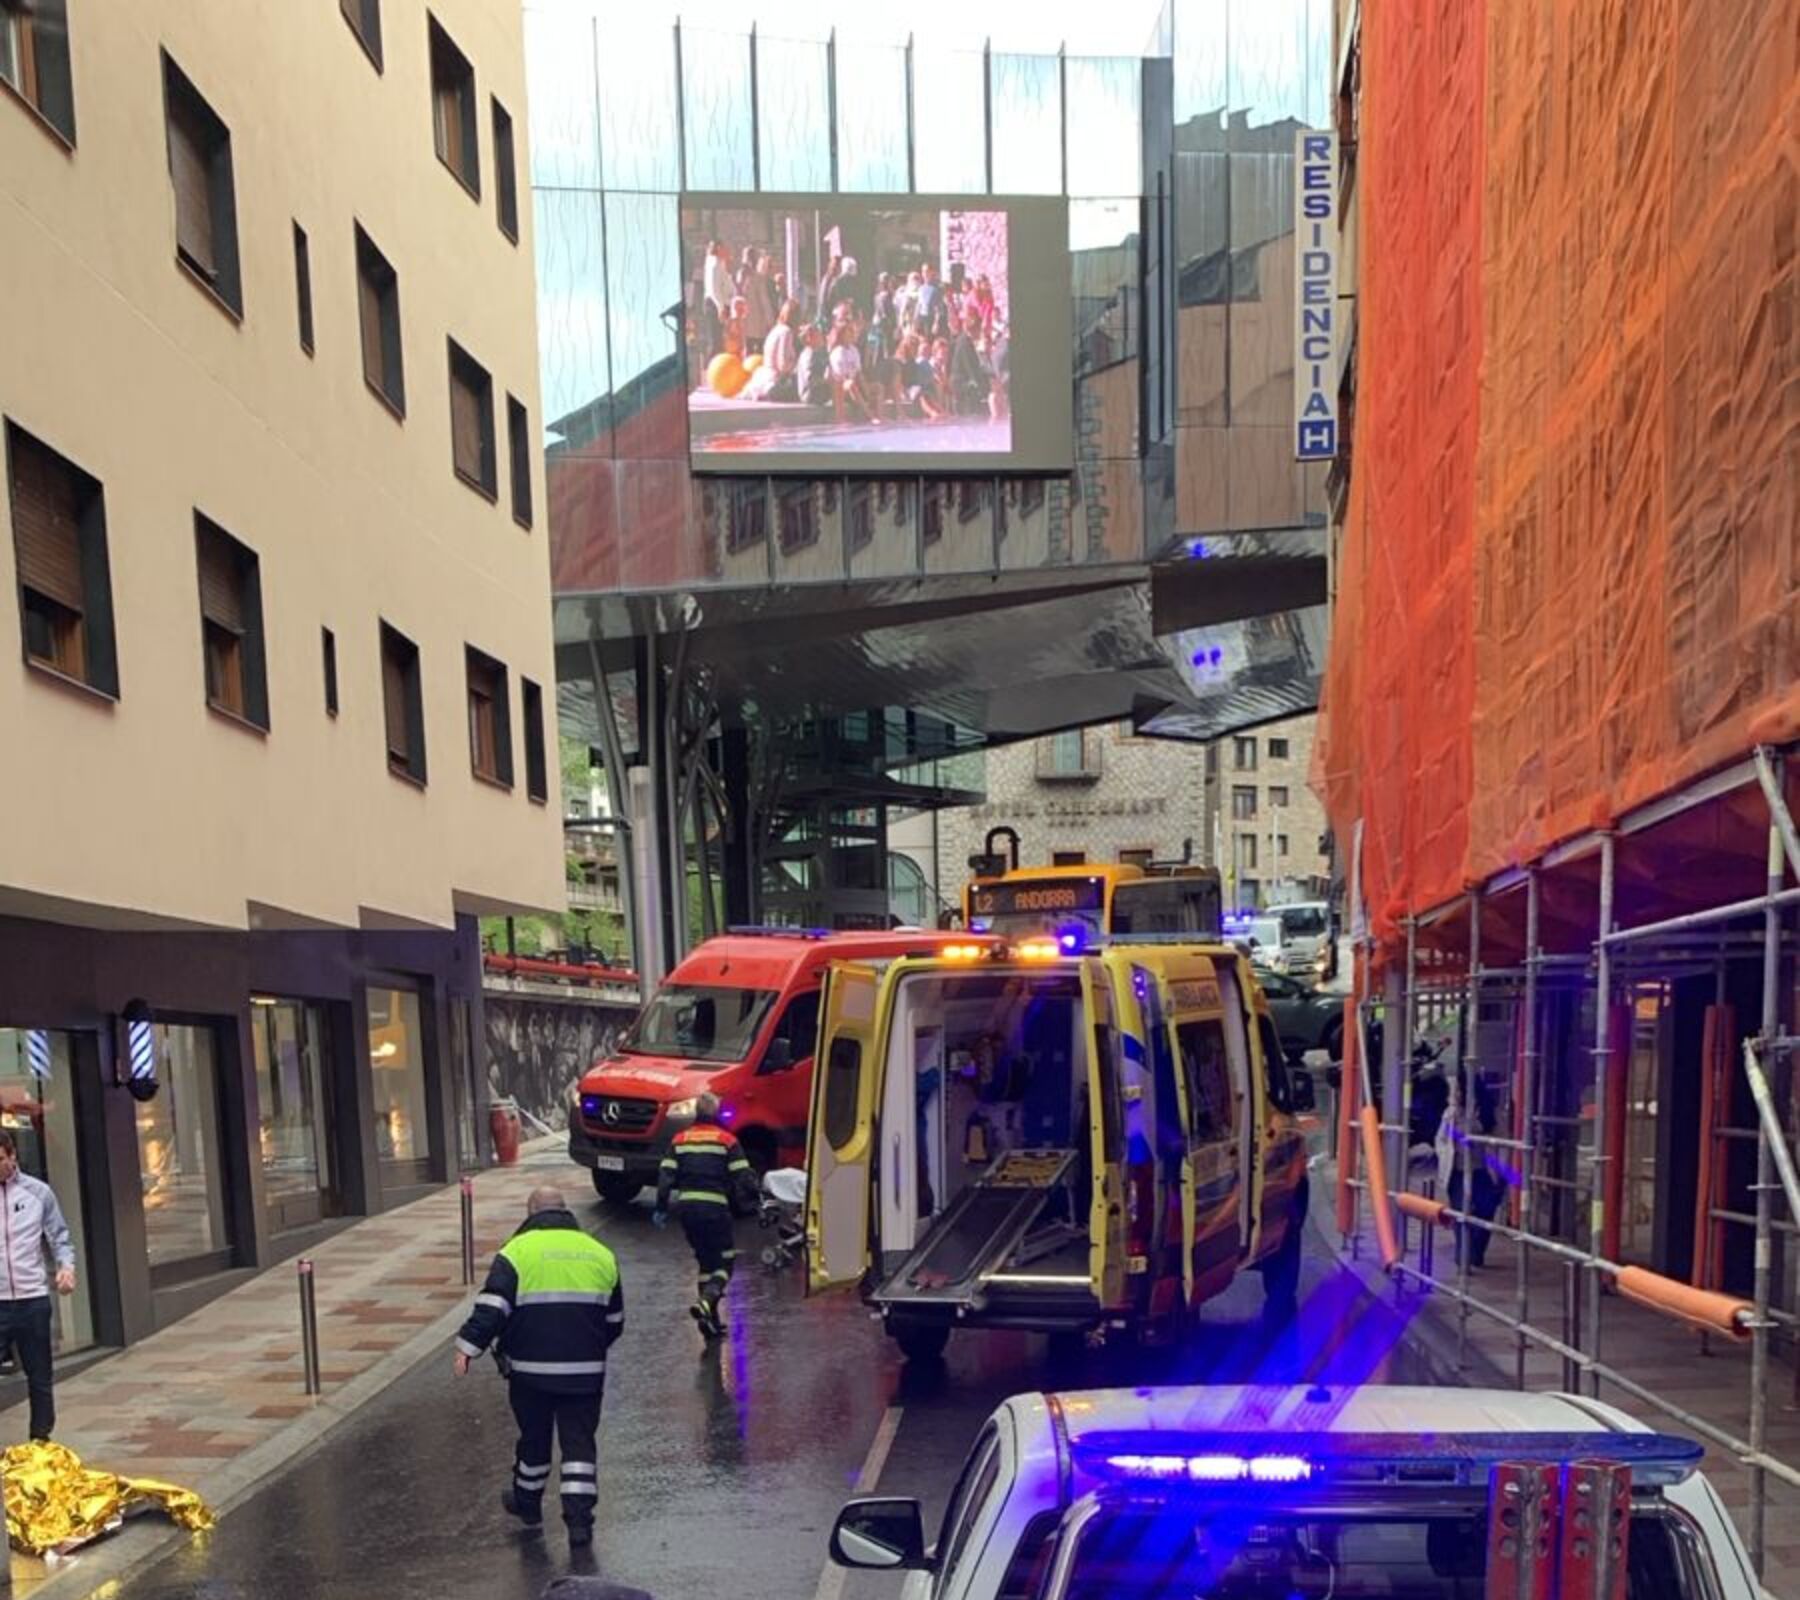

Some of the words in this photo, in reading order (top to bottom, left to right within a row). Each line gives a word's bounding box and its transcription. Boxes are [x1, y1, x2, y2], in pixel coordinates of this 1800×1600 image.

[1303, 136, 1332, 417] RESIDENCIA
[975, 893, 993, 912] L2
[1015, 888, 1076, 909] ANDORRA
